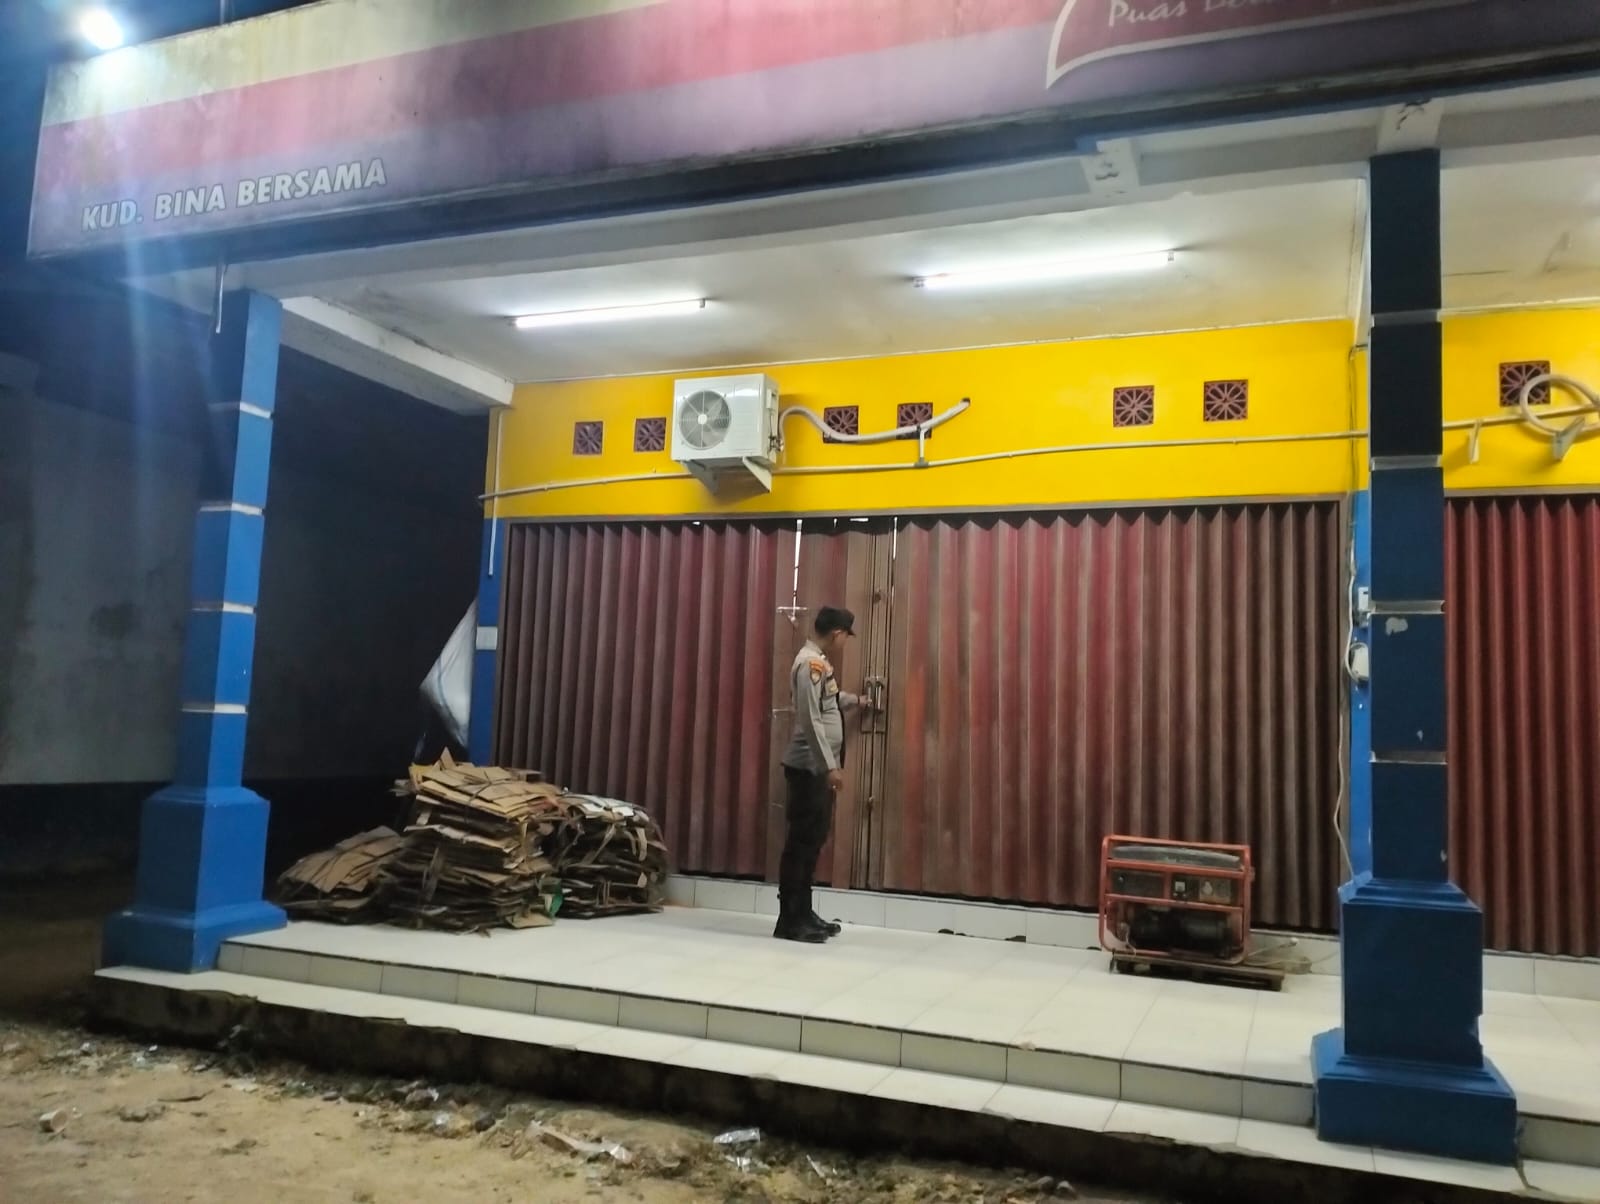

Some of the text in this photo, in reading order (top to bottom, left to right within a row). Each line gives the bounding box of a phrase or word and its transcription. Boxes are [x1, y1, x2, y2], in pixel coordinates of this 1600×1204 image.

[1108, 0, 1187, 27] Puas
[81, 157, 387, 232] KUD. BINA BERSAMA
